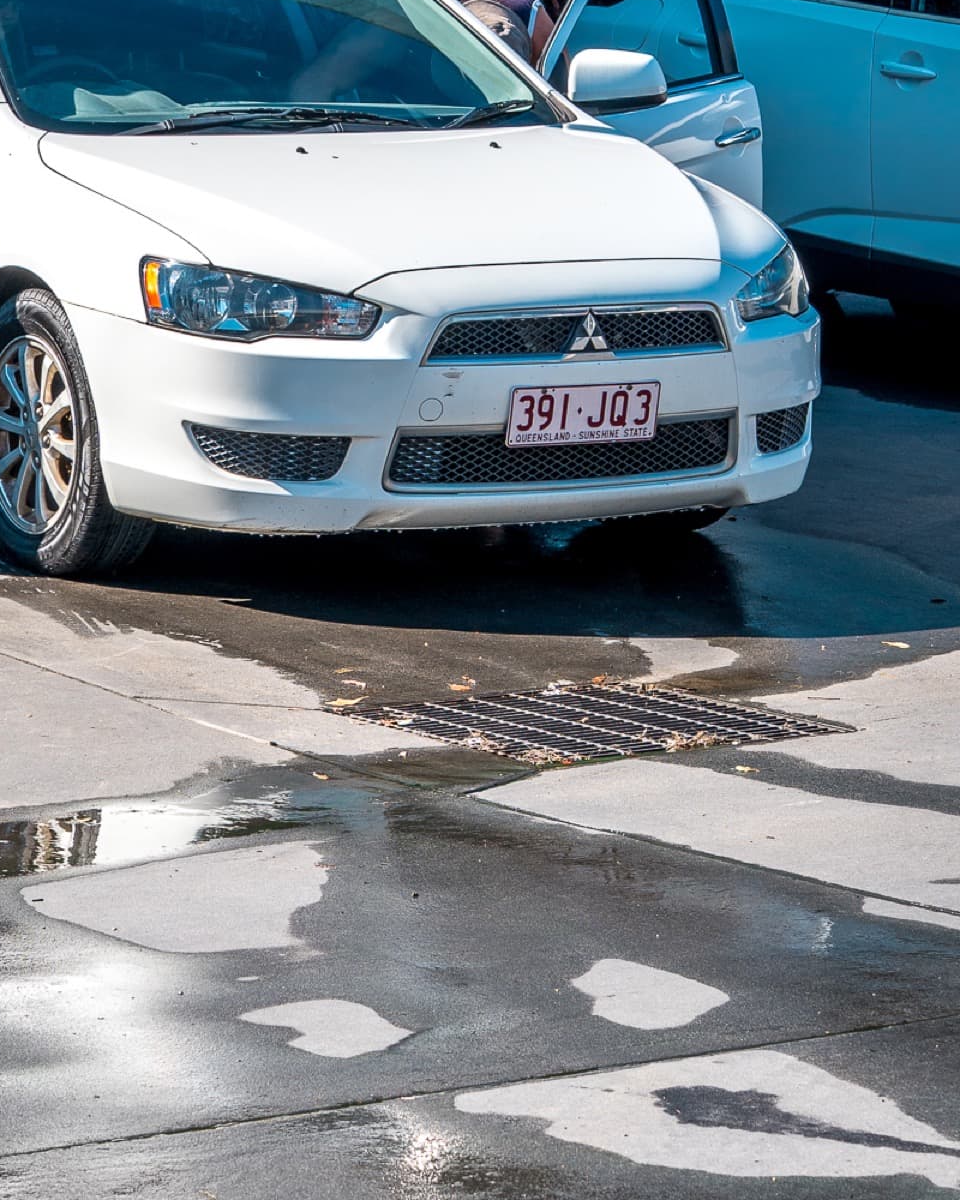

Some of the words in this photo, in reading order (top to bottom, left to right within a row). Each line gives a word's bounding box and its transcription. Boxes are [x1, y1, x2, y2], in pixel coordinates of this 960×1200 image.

[515, 431, 571, 443] QUEENSLAND
[578, 429, 620, 440] SUNSHINE
[623, 427, 648, 438] STATE
